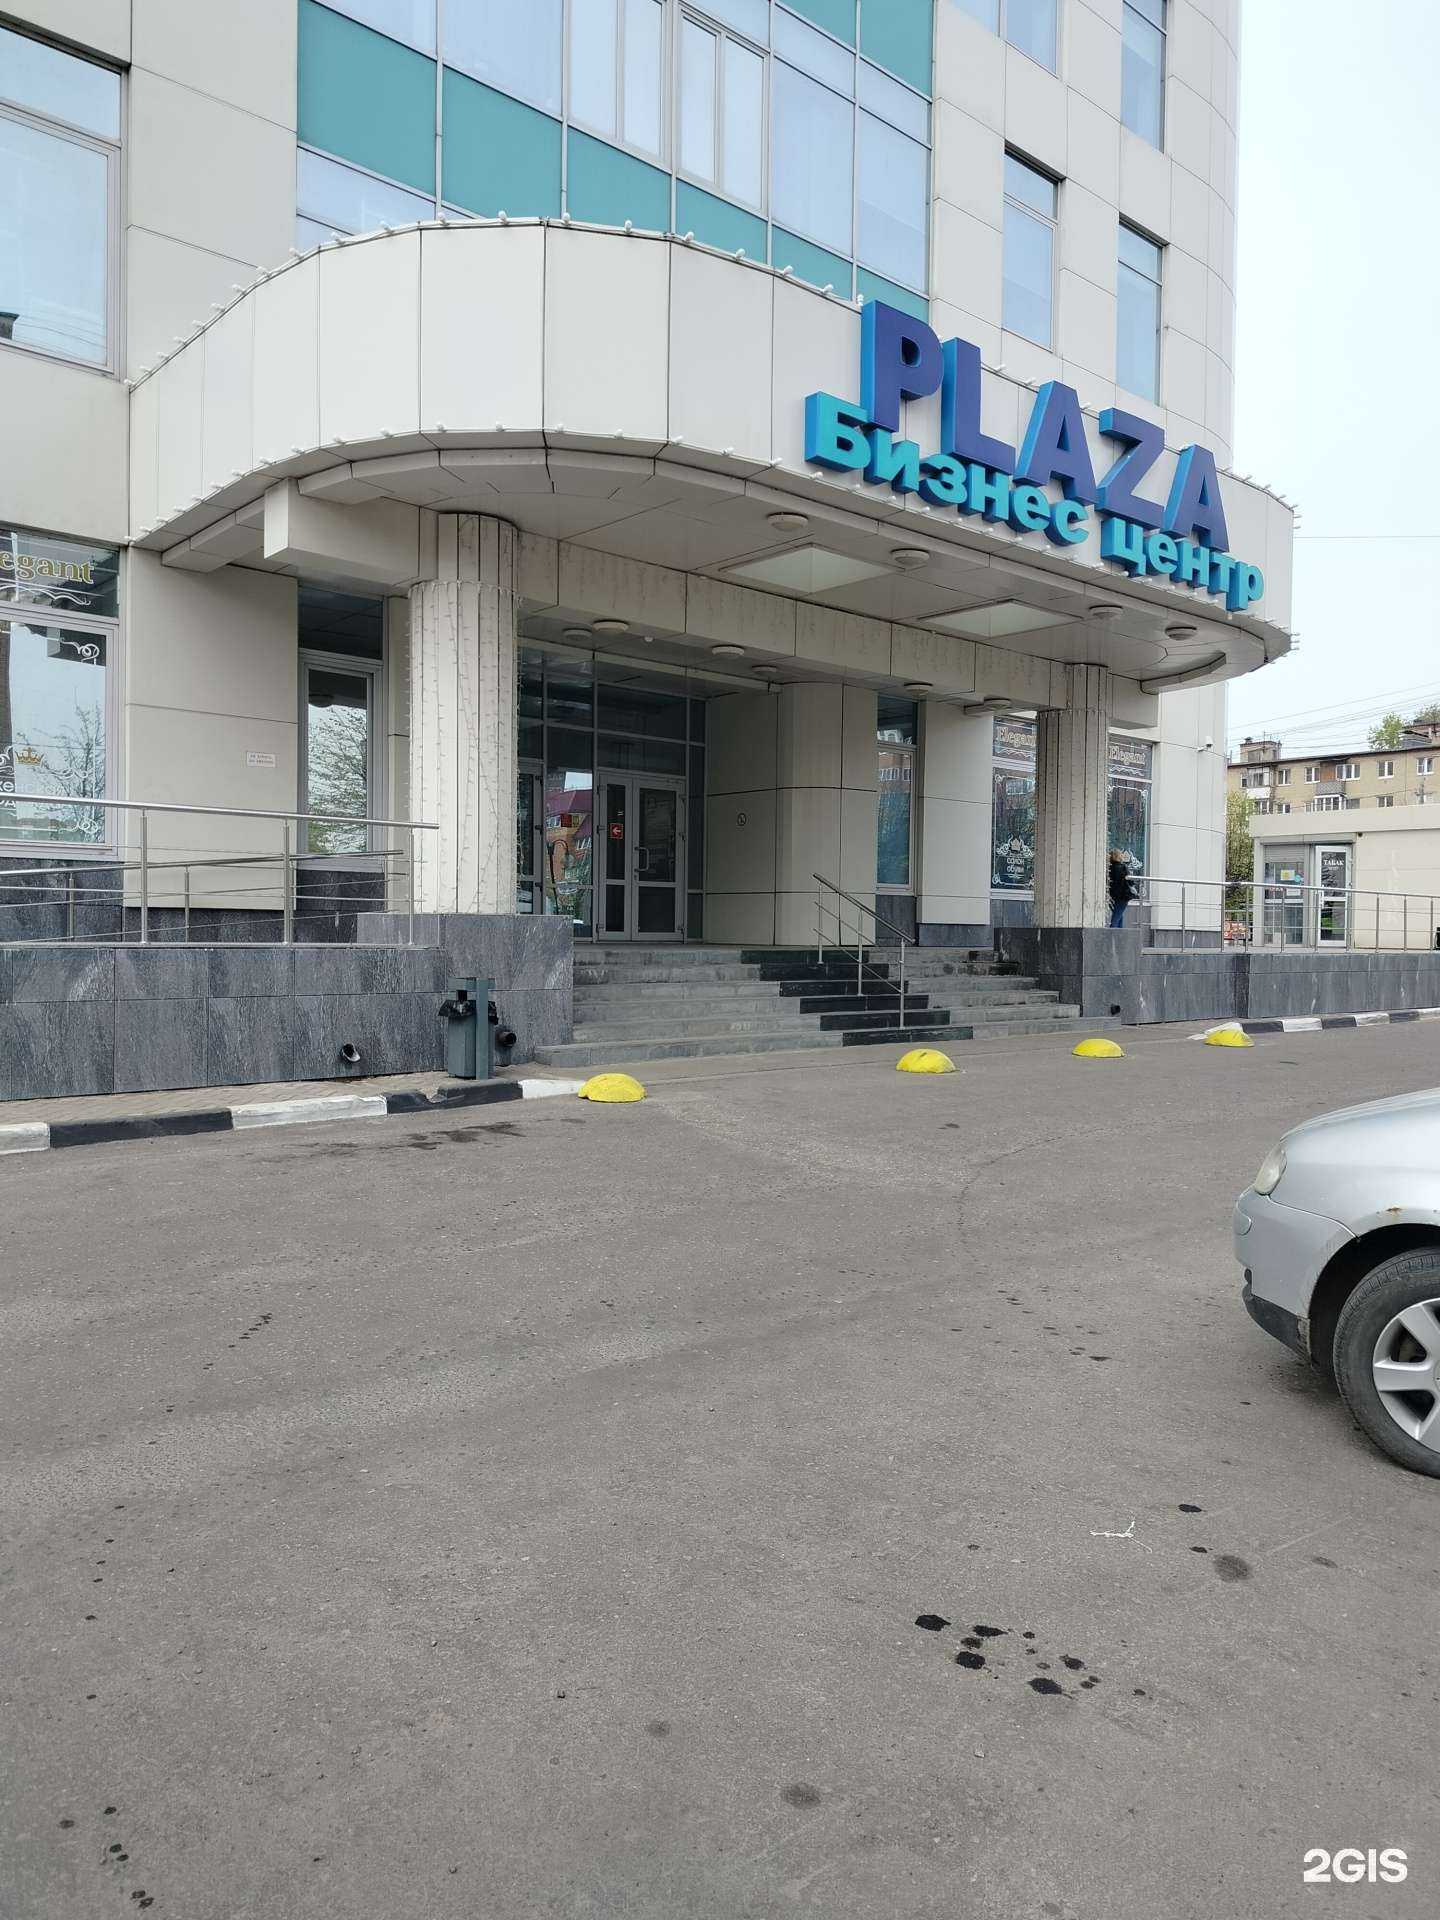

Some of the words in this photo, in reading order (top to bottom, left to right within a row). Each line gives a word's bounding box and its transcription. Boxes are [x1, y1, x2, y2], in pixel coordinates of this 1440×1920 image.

[805, 391, 1090, 547] Бизнес
[1101, 518, 1265, 613] центр
[861, 300, 1230, 553] PLAZA
